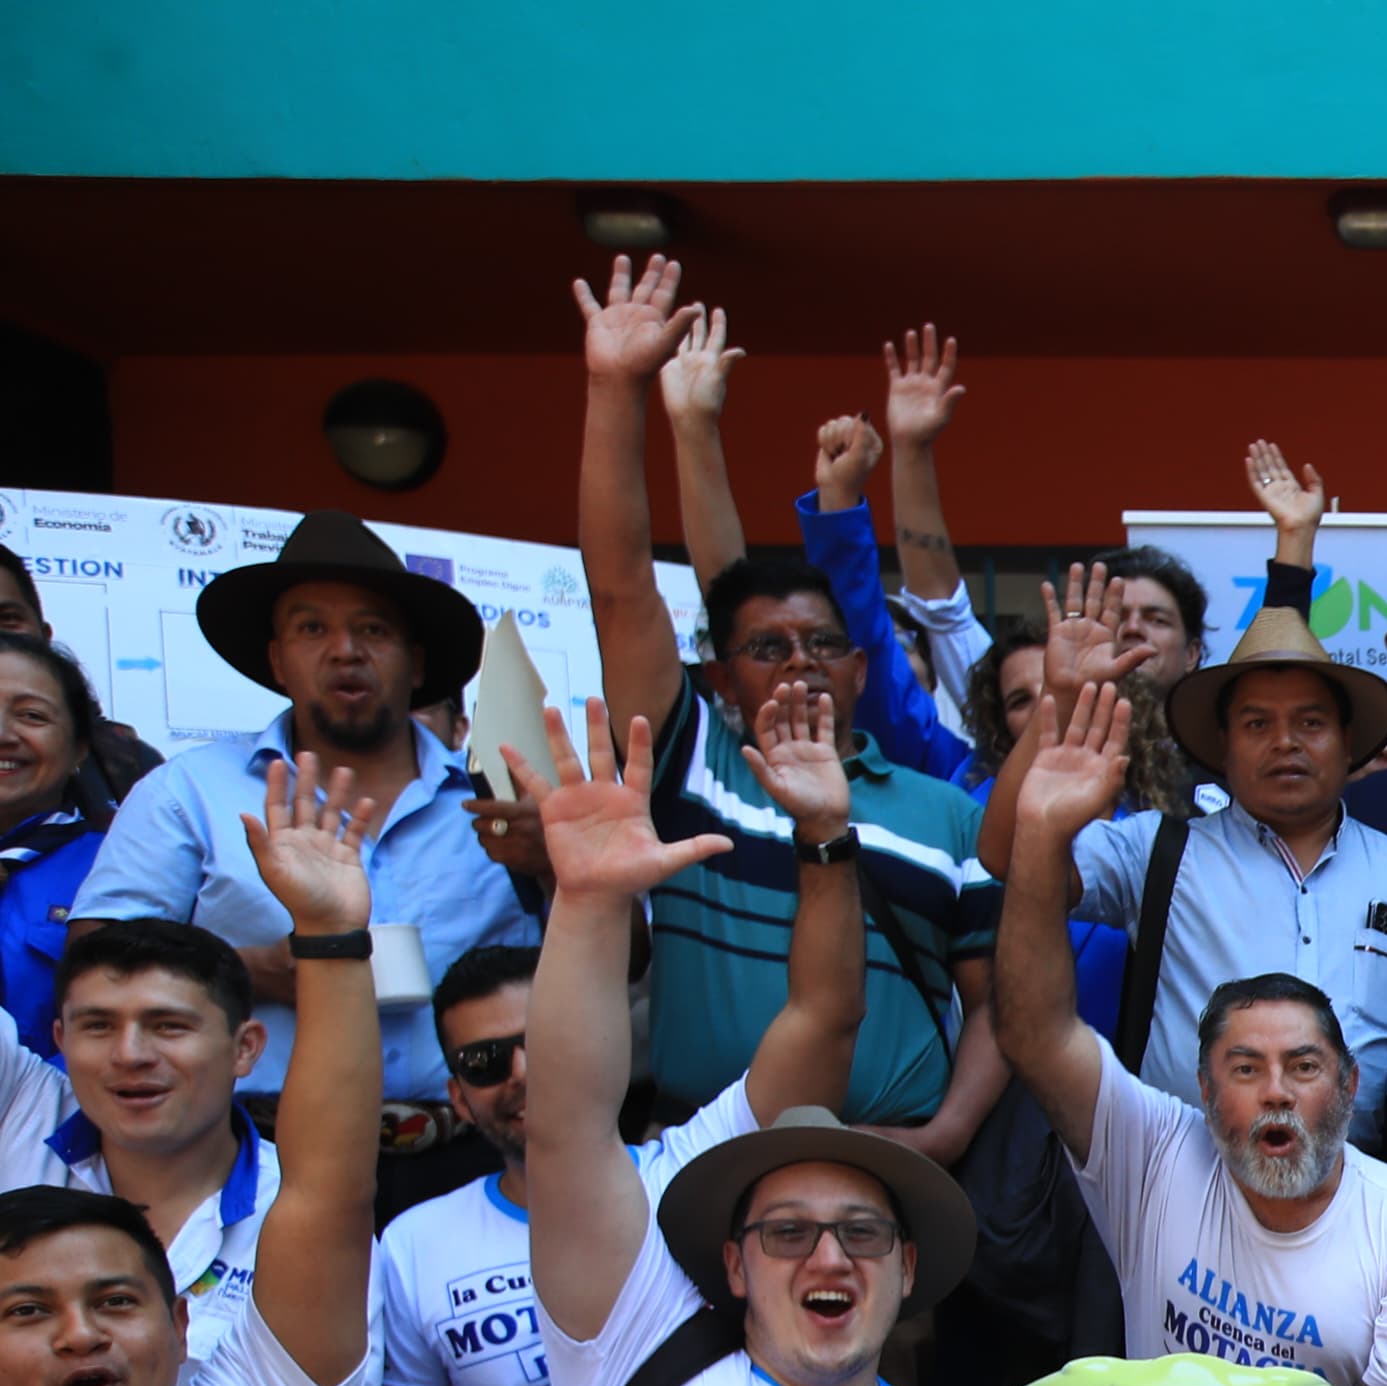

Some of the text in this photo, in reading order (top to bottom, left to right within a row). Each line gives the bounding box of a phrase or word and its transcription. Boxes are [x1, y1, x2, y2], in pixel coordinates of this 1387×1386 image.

[33, 517, 112, 533] Economía
[21, 556, 124, 579] ESTION
[452, 1289, 477, 1307] la
[1178, 1257, 1324, 1348] ALIANZA
[1199, 1306, 1295, 1361] Cuenca del
